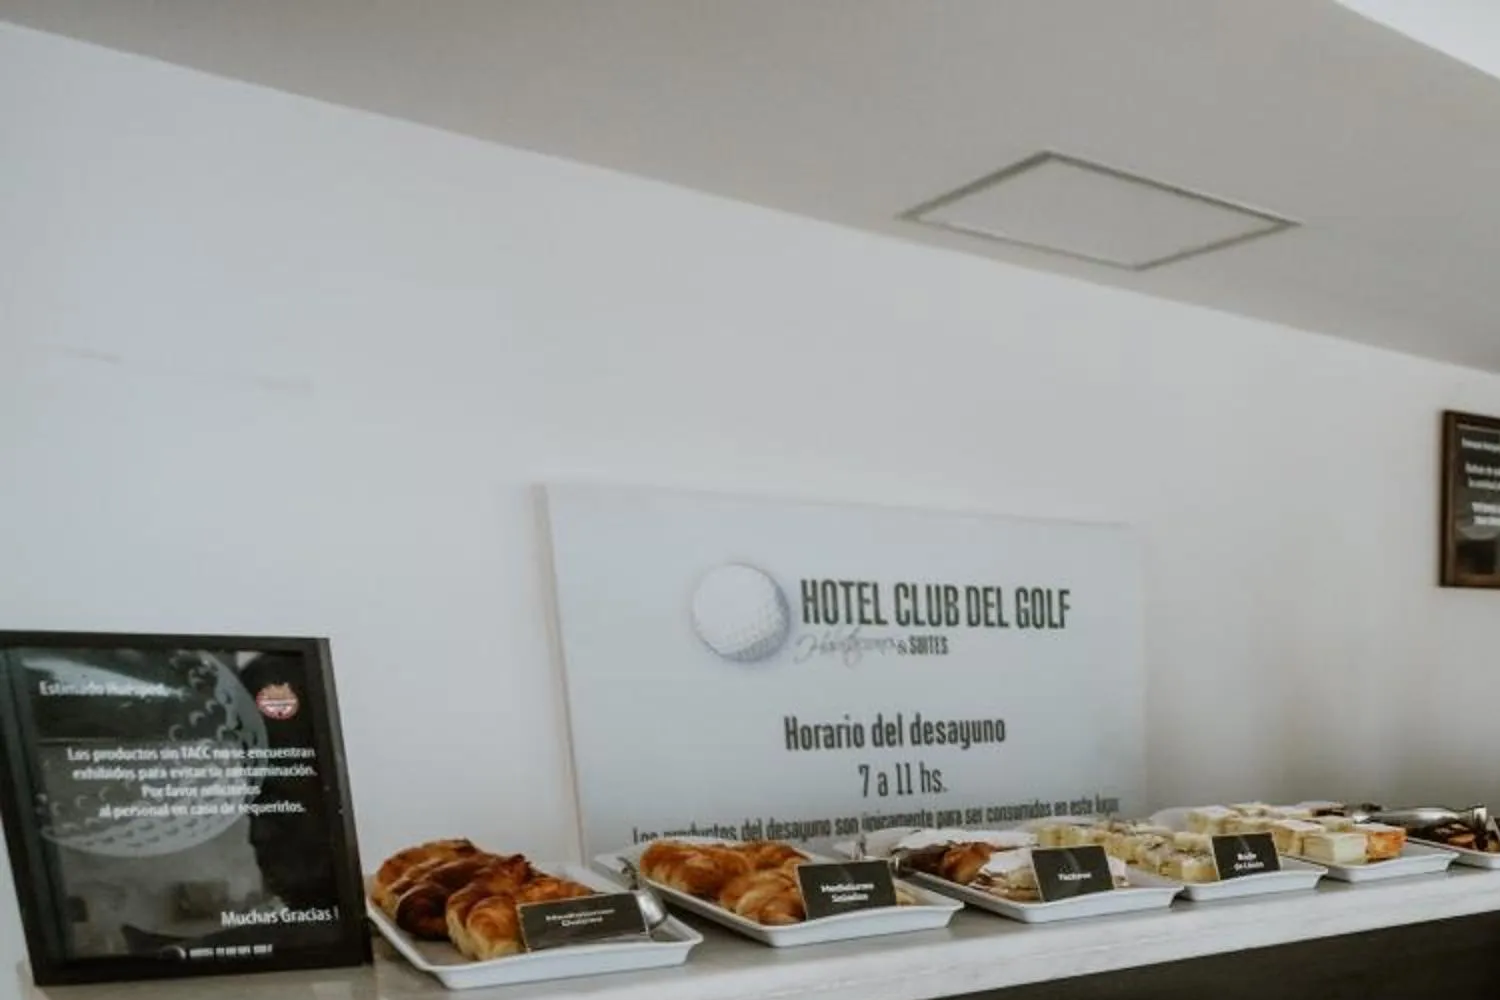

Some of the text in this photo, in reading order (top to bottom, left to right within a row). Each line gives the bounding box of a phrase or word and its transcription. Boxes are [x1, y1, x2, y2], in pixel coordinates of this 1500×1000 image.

[801, 579, 1071, 629] HOTEL CLUB DEL GOLF
[907, 634, 950, 656] SUITES
[784, 712, 1006, 751] Horario del desayuno
[248, 746, 316, 759] encuentran
[858, 761, 949, 797] 7 a 11 hs.
[113, 803, 169, 820] personal
[766, 817, 832, 842] desayuno
[834, 816, 859, 836] son
[965, 807, 983, 824] ser
[1055, 801, 1068, 815] en
[221, 907, 278, 927] Muchas
[280, 905, 332, 923] Gracias
